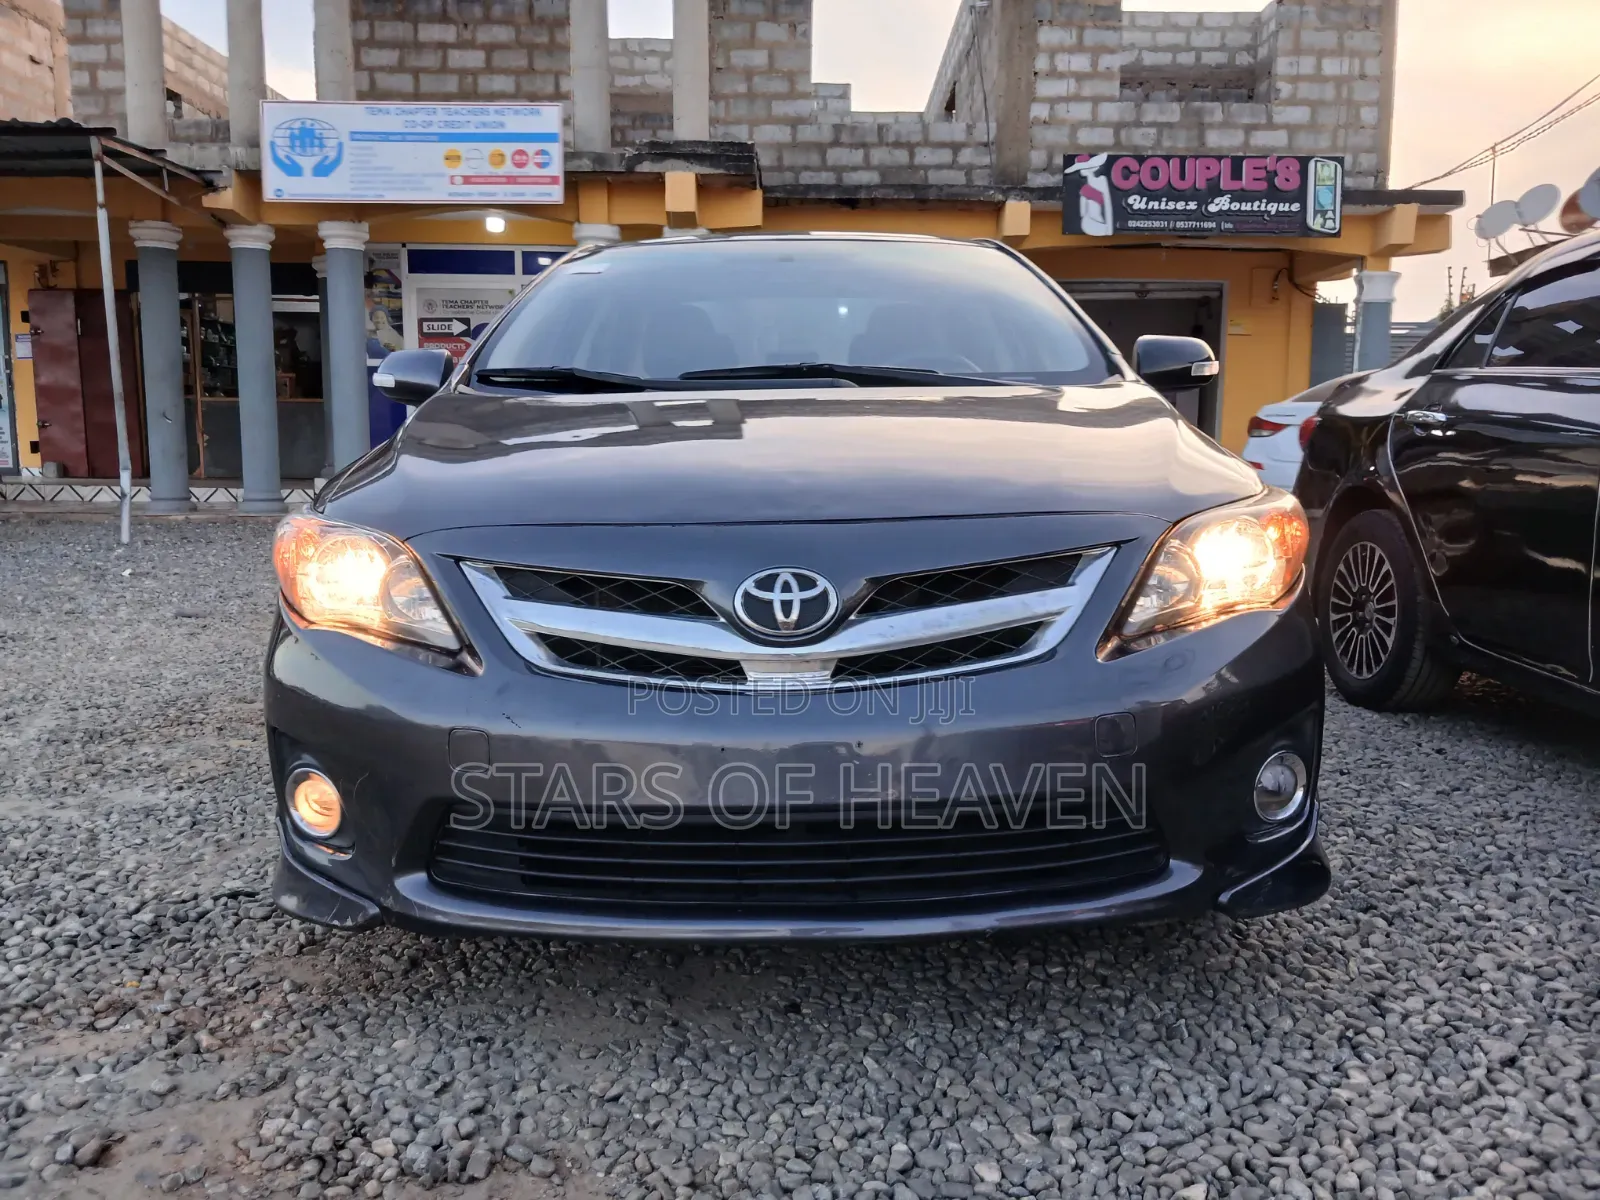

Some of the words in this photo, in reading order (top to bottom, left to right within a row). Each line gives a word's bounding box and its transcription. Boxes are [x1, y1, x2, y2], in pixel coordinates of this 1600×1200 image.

[395, 106, 438, 116] CHAPTER
[493, 107, 542, 116] NETWORK
[437, 120, 472, 129] CREDIT
[474, 120, 506, 129] UNION
[1110, 154, 1301, 191] COUPLE'S
[1126, 194, 1198, 211] Unisex
[1207, 194, 1301, 213] Boutique
